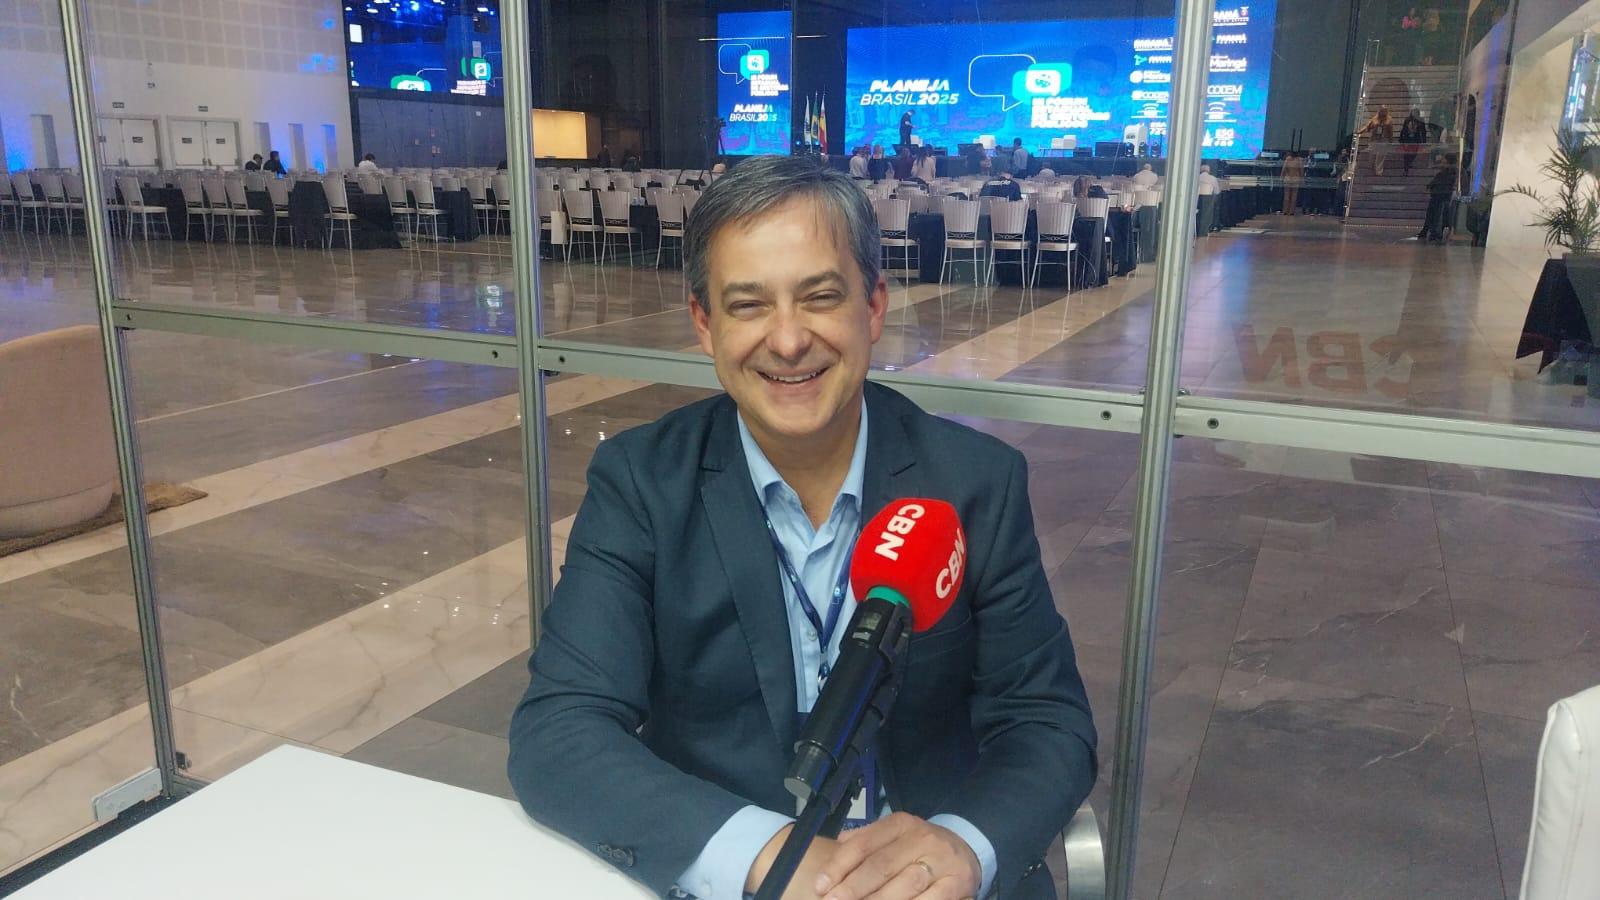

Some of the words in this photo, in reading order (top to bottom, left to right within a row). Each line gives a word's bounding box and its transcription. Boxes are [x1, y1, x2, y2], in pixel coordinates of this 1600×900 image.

[869, 79, 950, 92] PLANEJA
[733, 104, 773, 113] PLANEJA
[874, 503, 926, 562] CBN
[935, 527, 966, 599] CBN
